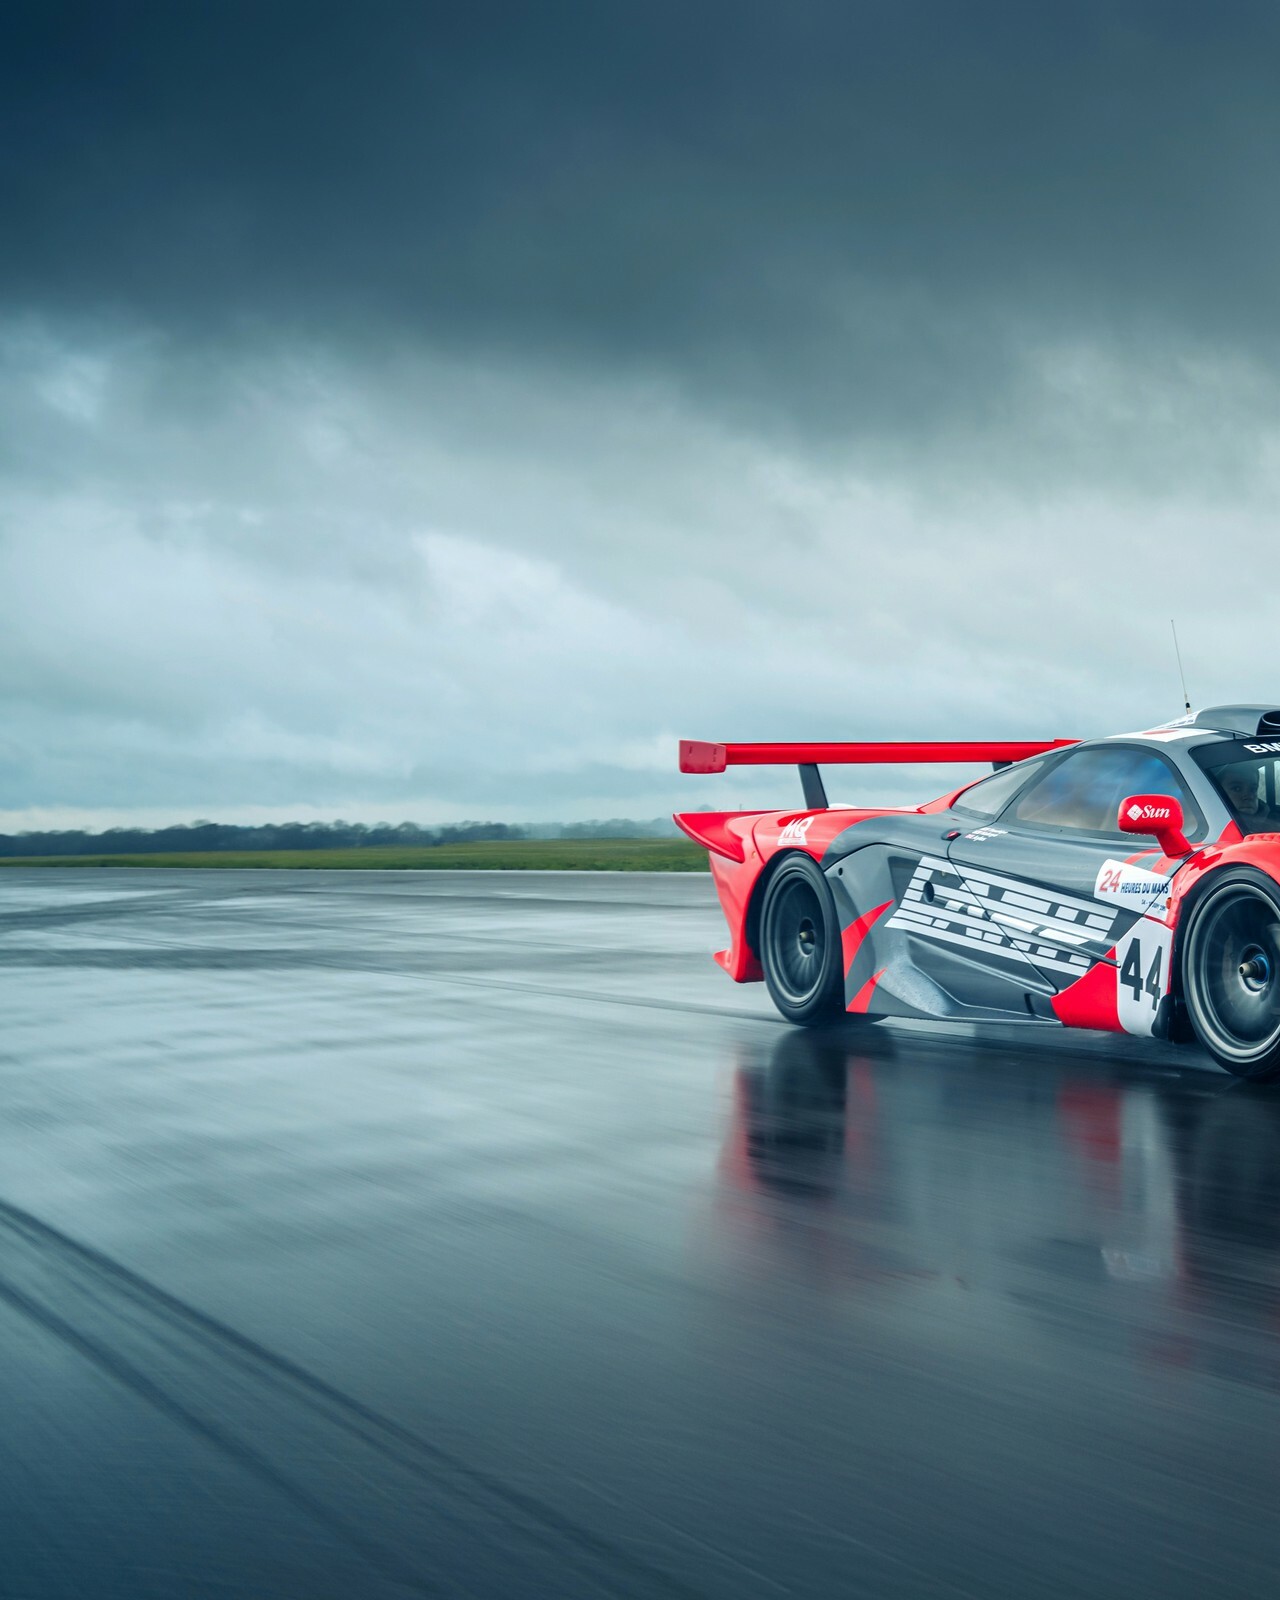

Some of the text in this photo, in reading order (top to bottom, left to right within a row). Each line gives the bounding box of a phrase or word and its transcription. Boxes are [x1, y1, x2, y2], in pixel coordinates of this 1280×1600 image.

[1142, 804, 1170, 818] Sun
[1099, 869, 1169, 894] 24 HEURES DU MANS
[1120, 937, 1162, 1012] 44
